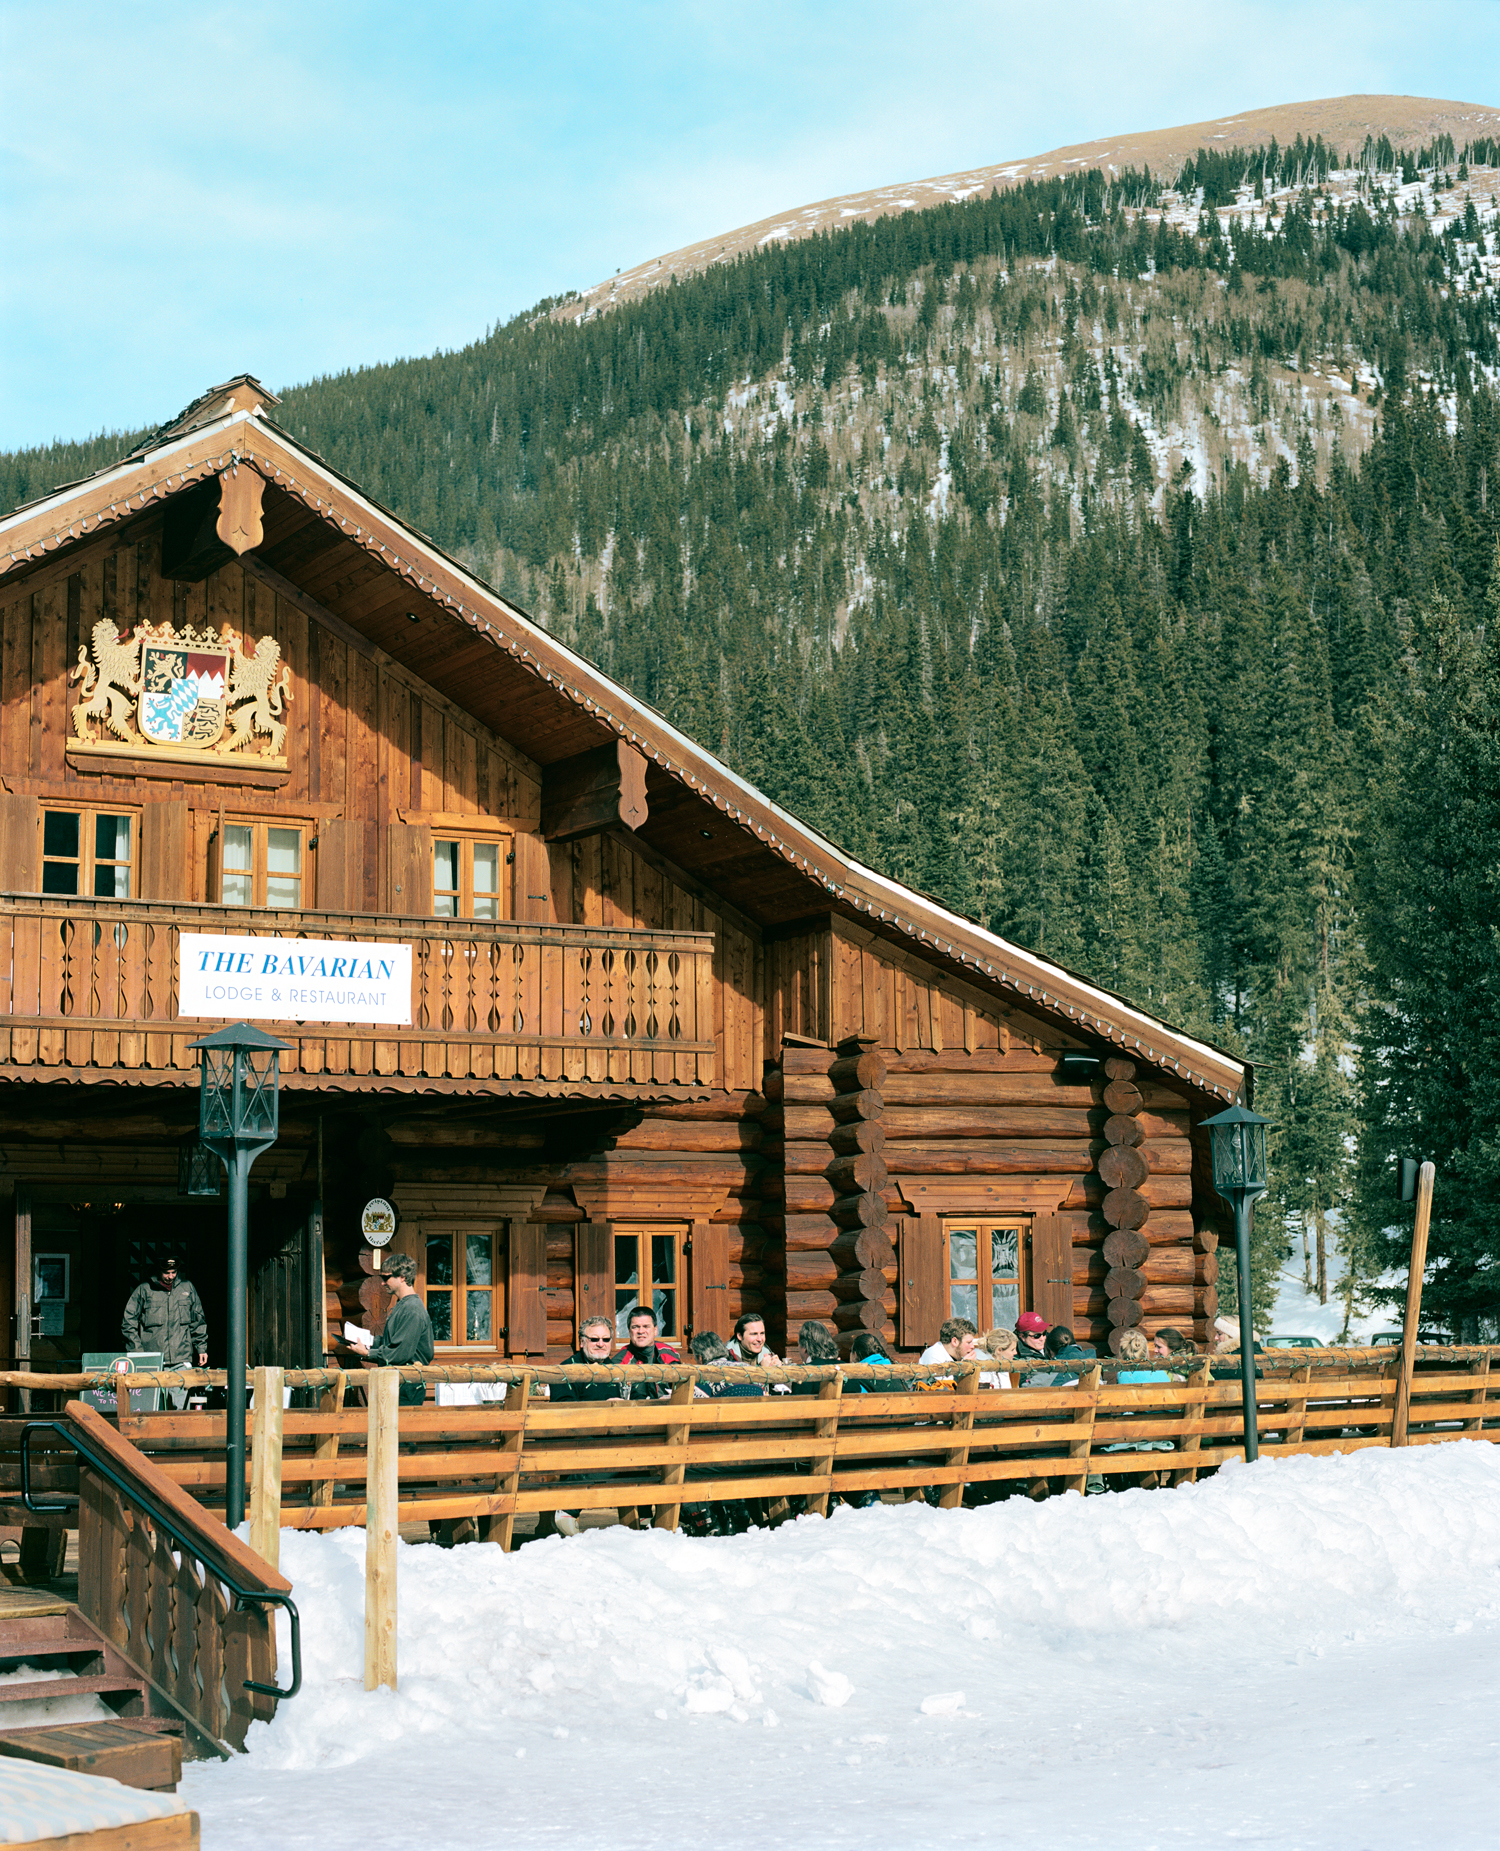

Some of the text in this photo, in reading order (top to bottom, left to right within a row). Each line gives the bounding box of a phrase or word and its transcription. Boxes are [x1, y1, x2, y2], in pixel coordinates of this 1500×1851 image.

[198, 951, 395, 979] THE BAVARIAN
[205, 985, 387, 1006] LODGE & RESTAURANT
